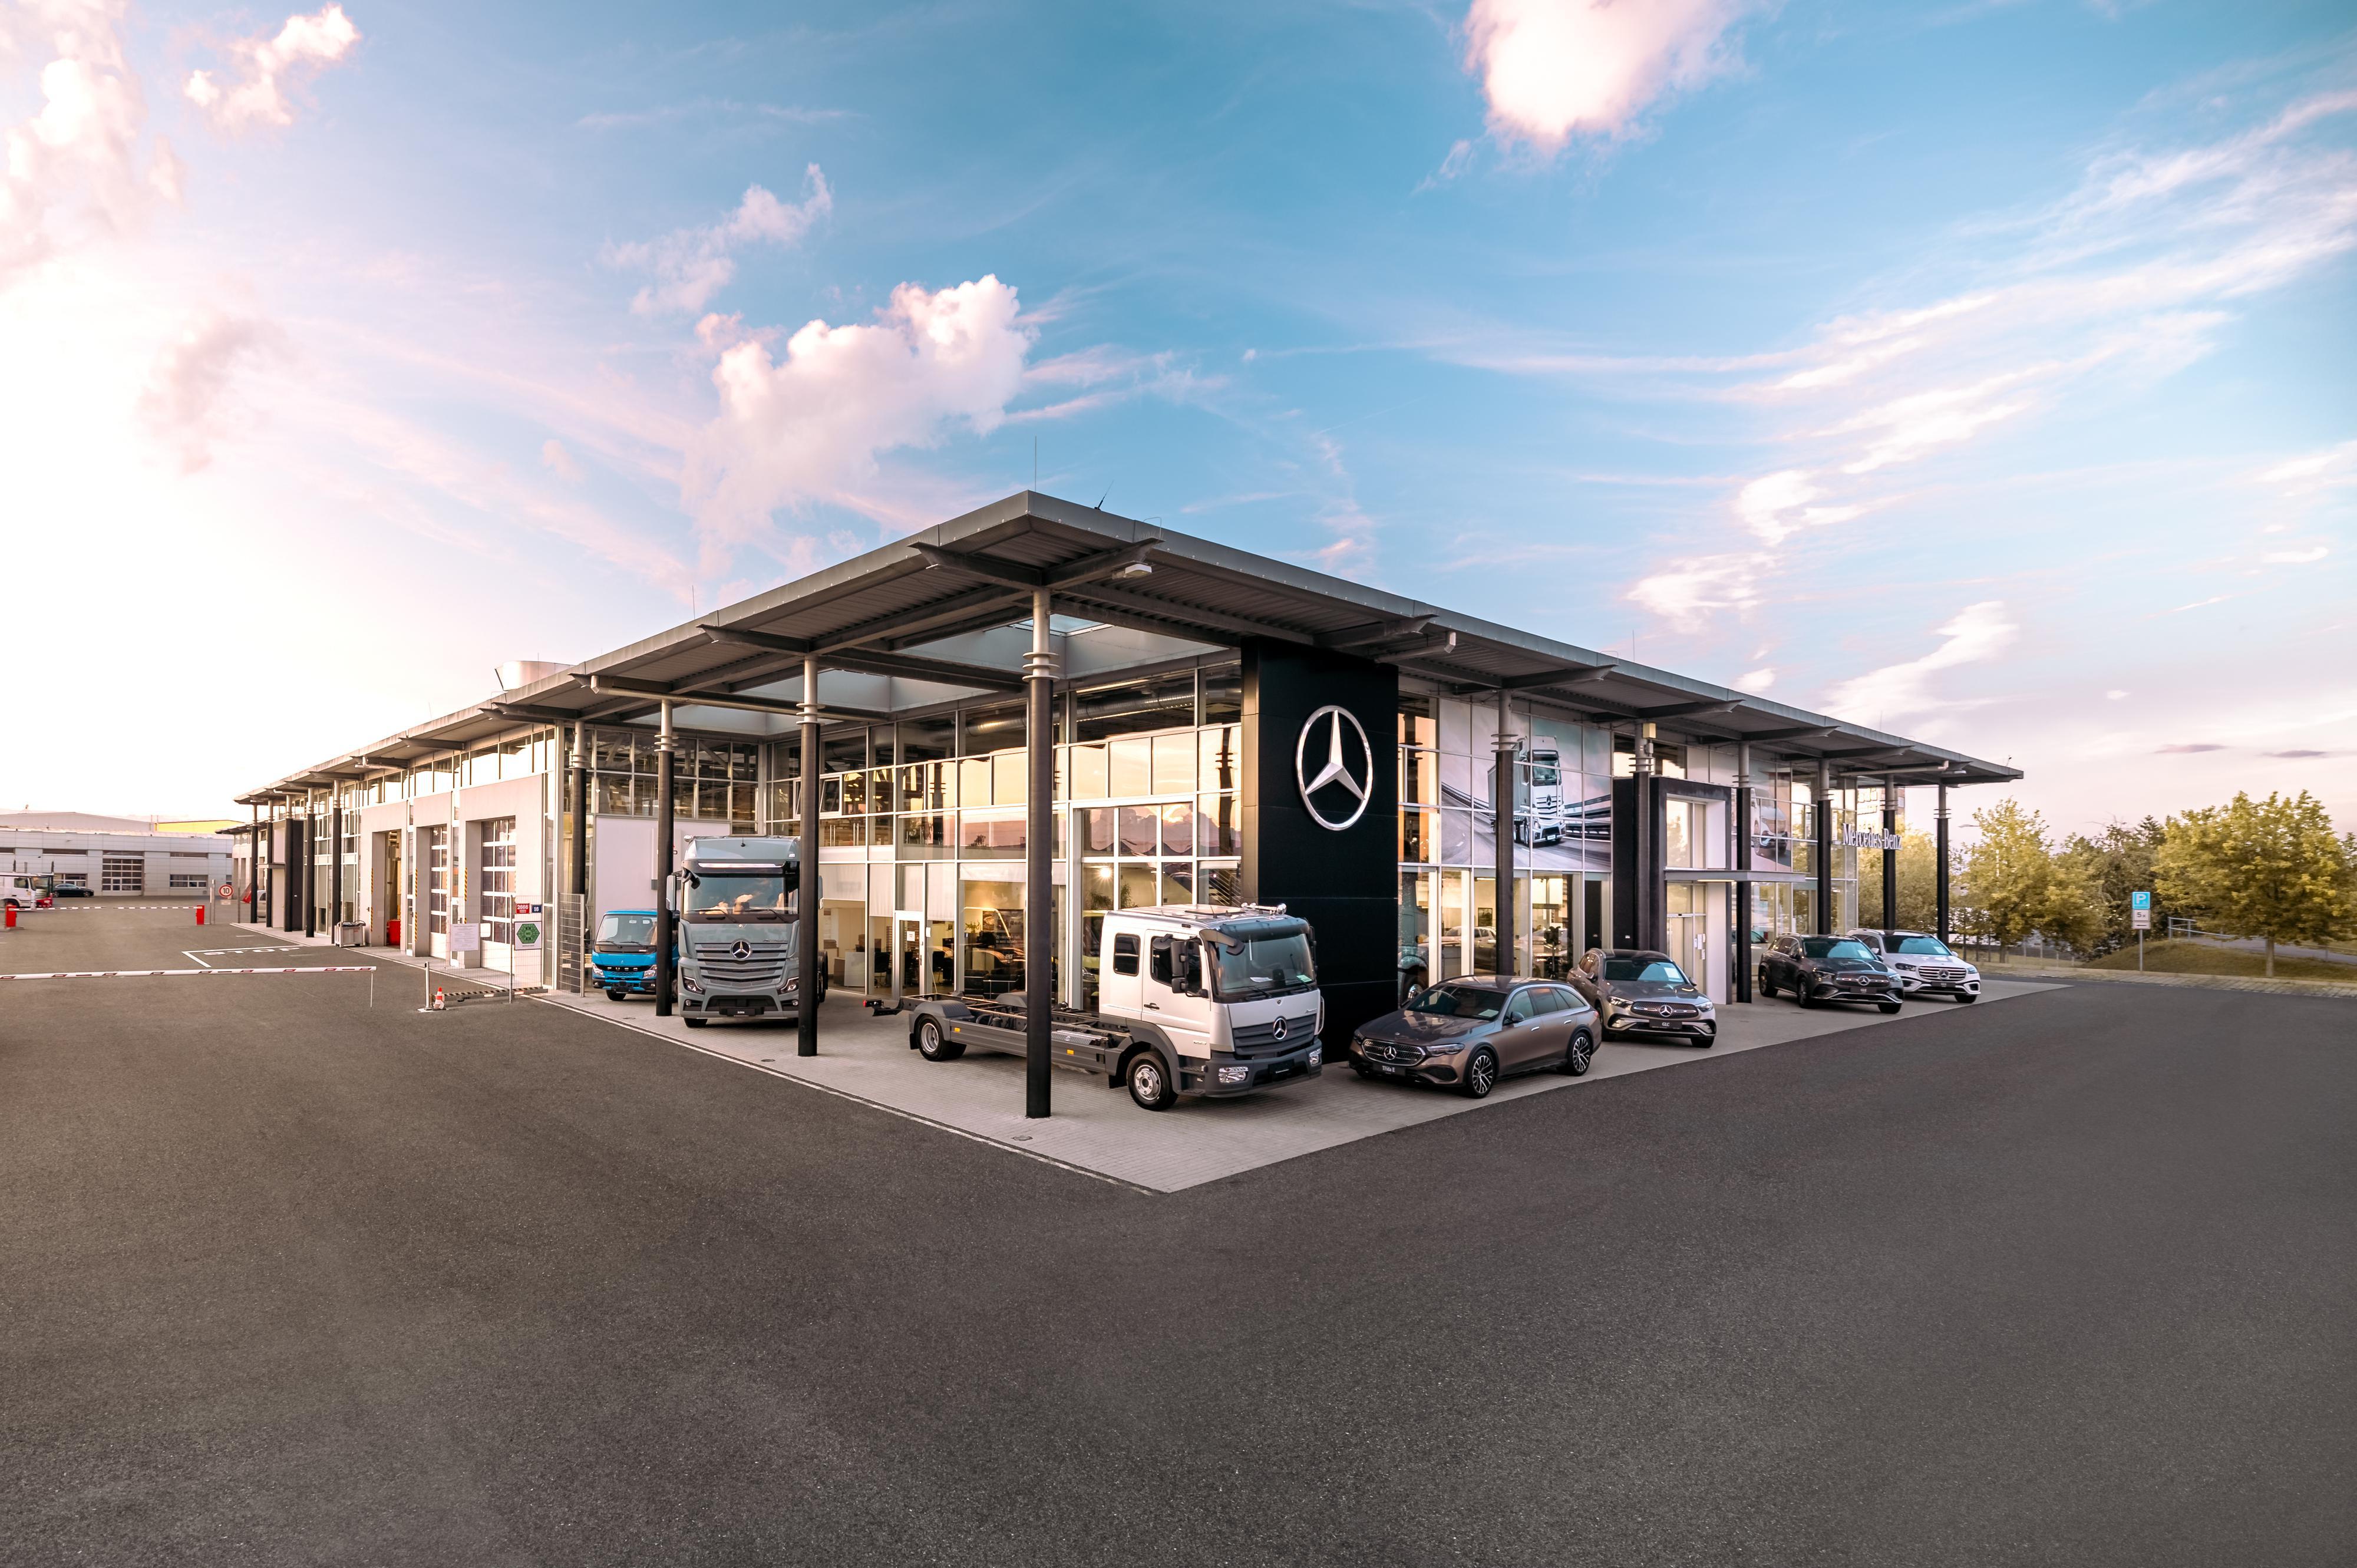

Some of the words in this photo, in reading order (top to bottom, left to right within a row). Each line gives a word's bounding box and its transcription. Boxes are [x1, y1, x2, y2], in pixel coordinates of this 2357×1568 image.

[1843, 823, 1902, 850] Mercedes-Benz
[2136, 893, 2146, 904] P
[204, 948, 300, 956] STOP
